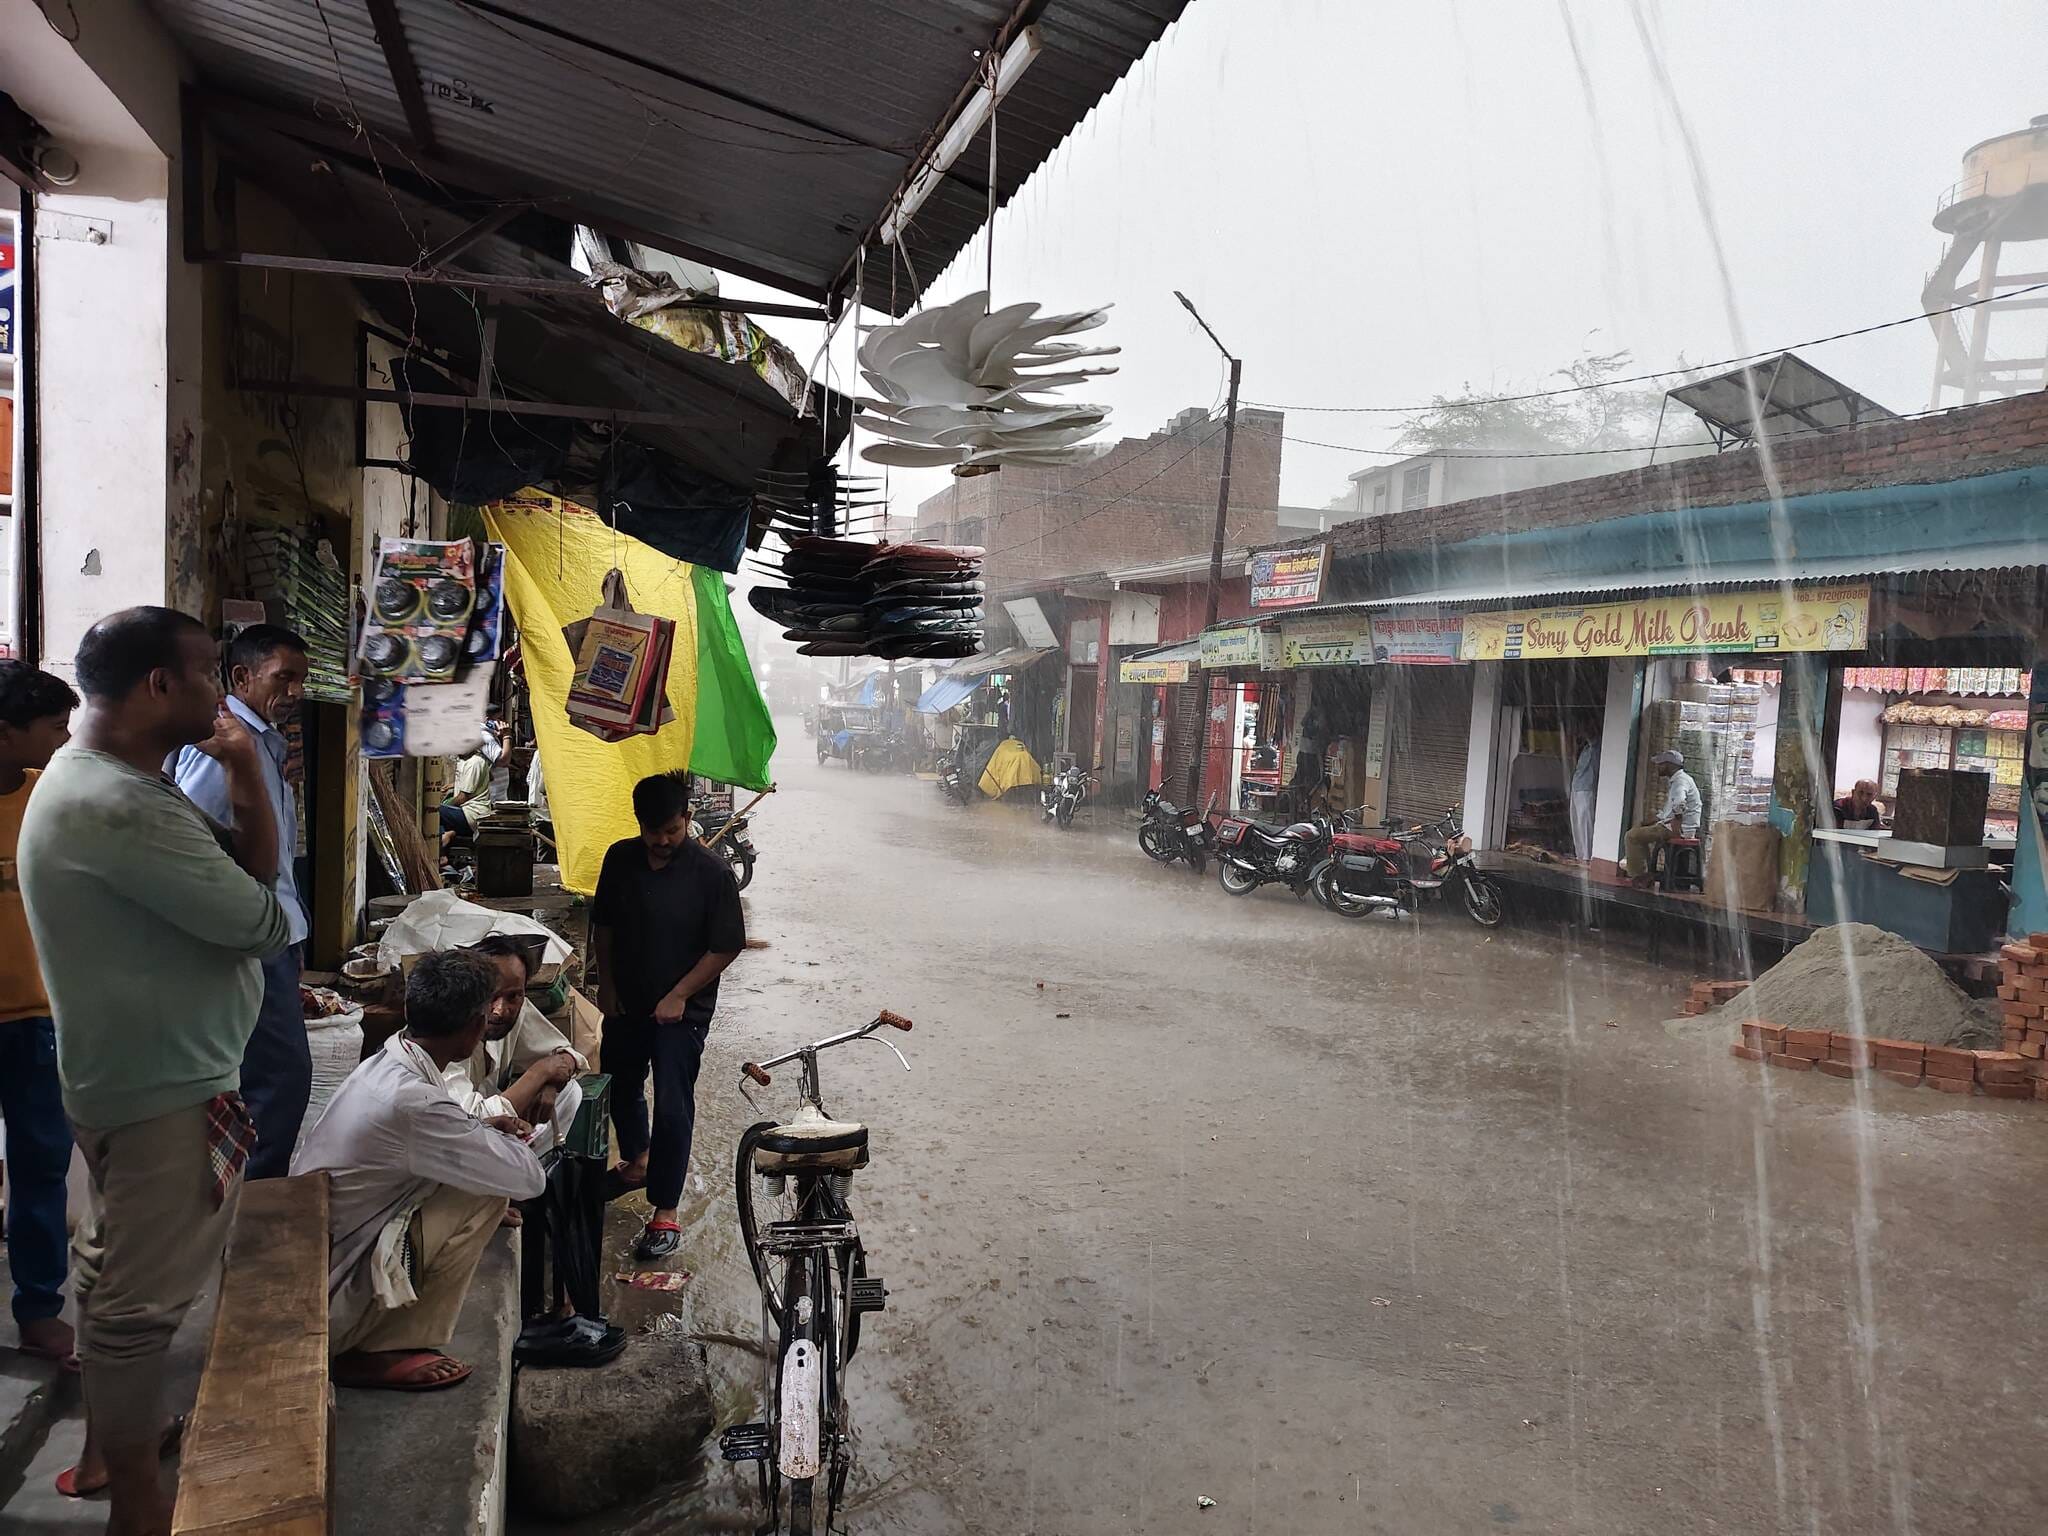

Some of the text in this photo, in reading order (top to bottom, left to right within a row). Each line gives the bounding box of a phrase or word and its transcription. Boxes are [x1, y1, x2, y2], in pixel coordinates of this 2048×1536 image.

[1526, 604, 1752, 656] Sony Gold Milk Rusk
